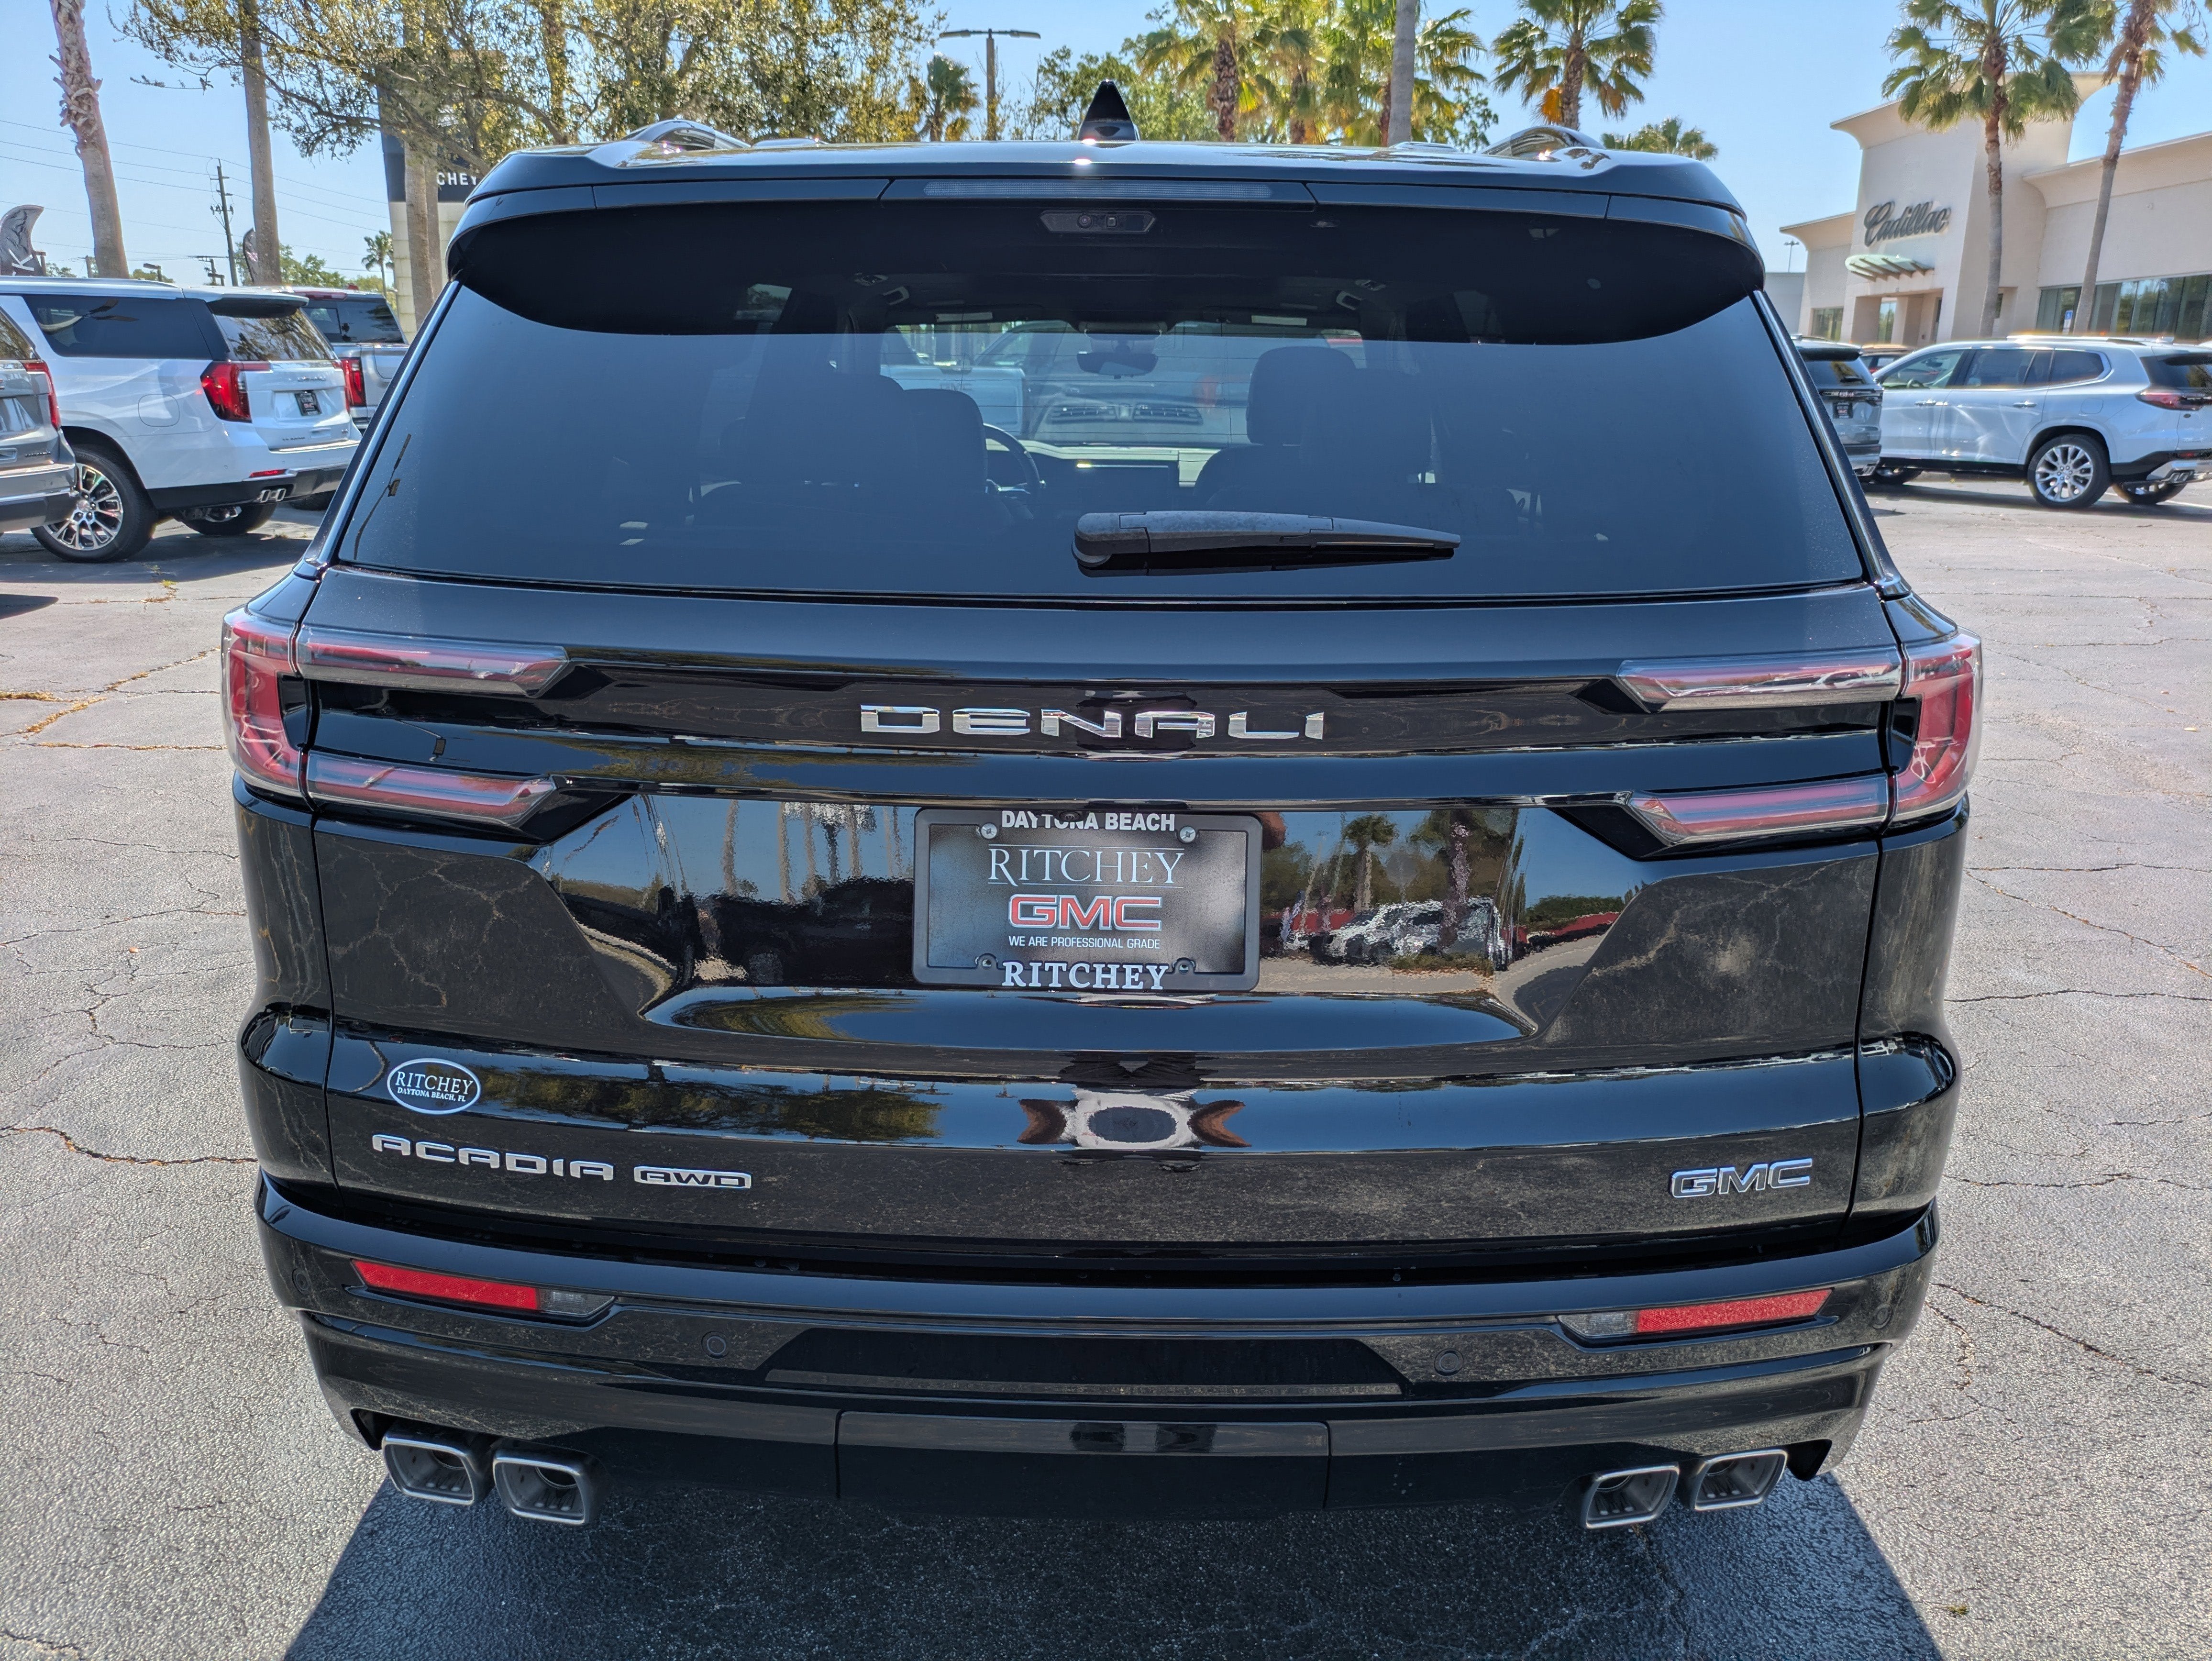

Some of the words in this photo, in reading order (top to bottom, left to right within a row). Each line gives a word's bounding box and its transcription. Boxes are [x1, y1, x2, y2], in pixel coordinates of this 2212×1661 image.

[436, 172, 477, 185] CHEY
[1864, 201, 1950, 247] Cadillac
[860, 704, 1324, 740] DENALI
[1105, 813, 1175, 831] BEACH
[988, 848, 1185, 886] RITCHEY
[1008, 894, 1162, 931] GMC
[1008, 936, 1025, 946] WE
[1029, 936, 1048, 947] ARE
[1051, 937, 1123, 948] PROFESSIONAL
[1127, 938, 1160, 949] GRADE
[1002, 962, 1169, 990] RITCHEY
[395, 1071, 474, 1095] RITCHEY
[397, 1087, 430, 1097] DAYTONA
[431, 1091, 456, 1101] BEACH,
[372, 1134, 614, 1181] ACADIA
[634, 1166, 752, 1189] AWD
[1671, 1158, 1813, 1198] GMC
